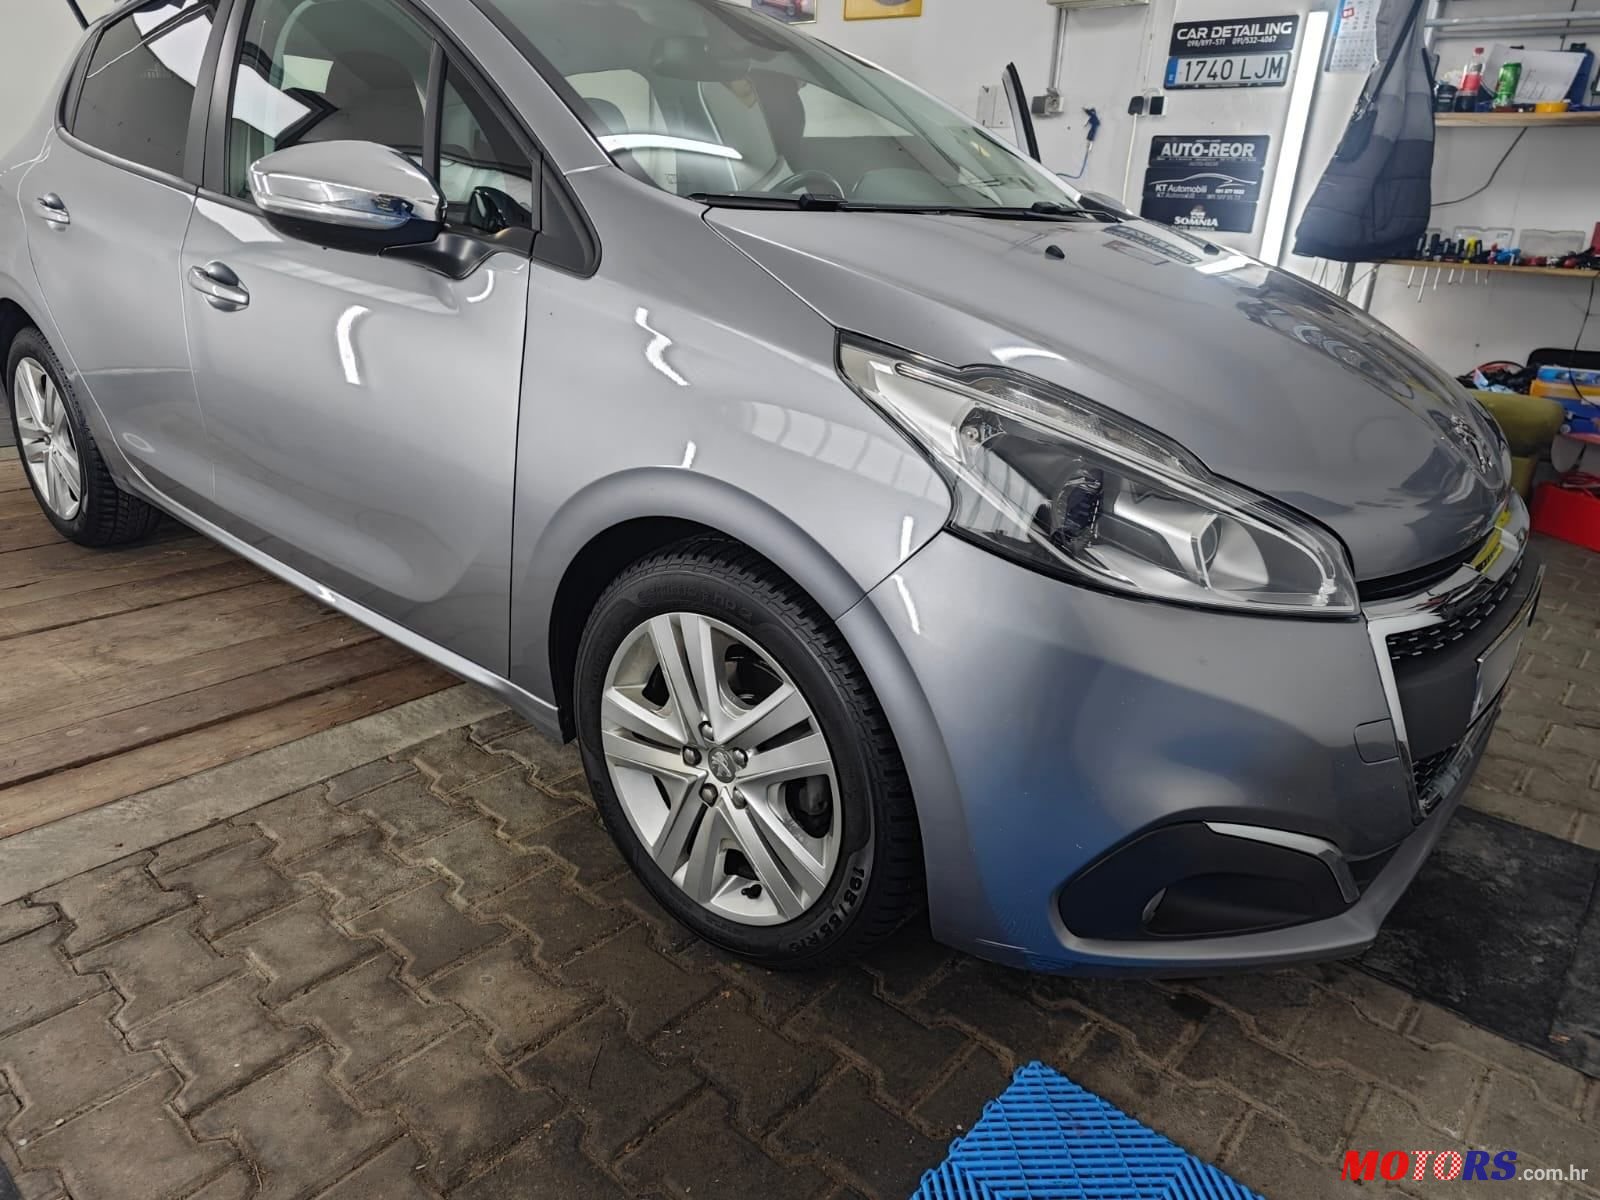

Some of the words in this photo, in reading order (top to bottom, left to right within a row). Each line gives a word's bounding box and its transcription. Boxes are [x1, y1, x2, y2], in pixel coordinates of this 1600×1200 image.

[1177, 27, 1208, 40] CAR
[1211, 21, 1293, 38] DETAILING
[1185, 59, 1233, 82] 1740
[1240, 56, 1284, 79] LJM
[1161, 143, 1255, 157] AUTO-REOR
[1155, 184, 1168, 192] KT
[1168, 184, 1208, 193] Automobili
[1174, 216, 1218, 227] SOMNIA
